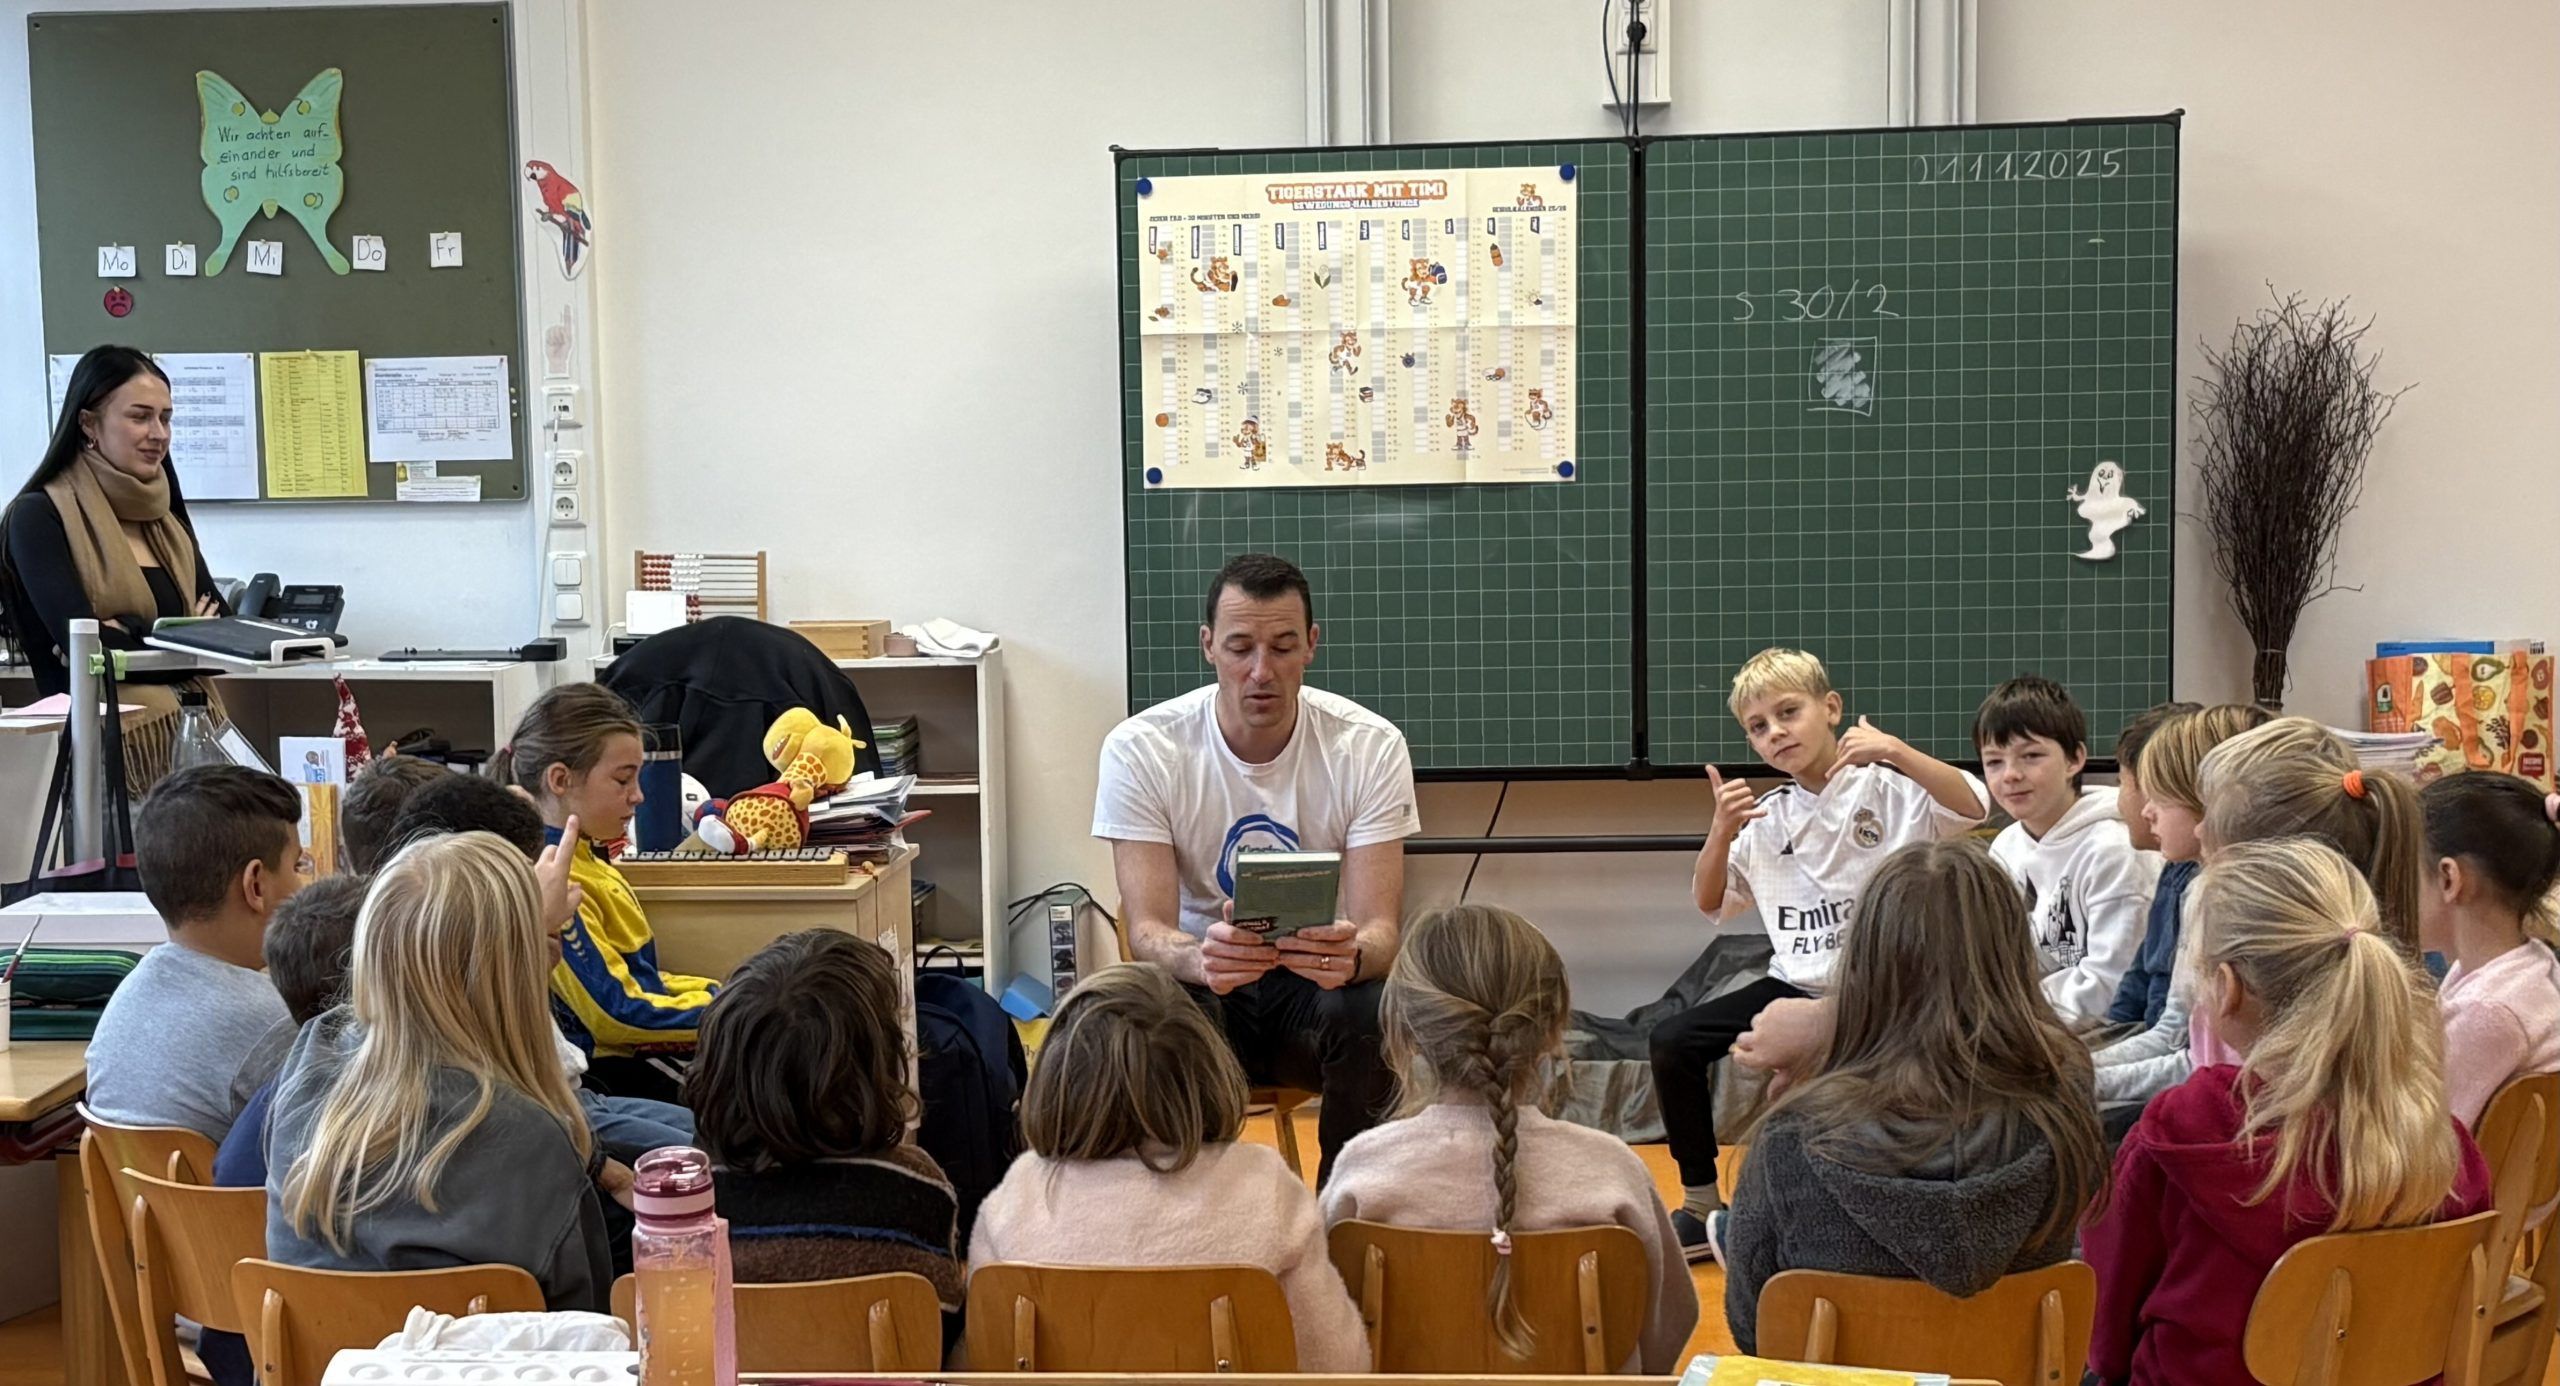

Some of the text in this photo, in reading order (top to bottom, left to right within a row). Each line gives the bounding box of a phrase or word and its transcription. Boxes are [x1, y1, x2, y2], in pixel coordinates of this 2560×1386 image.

[218, 126, 239, 142] Wir
[246, 126, 291, 141] achten
[219, 143, 316, 164] einander und
[231, 163, 330, 181] sind hilfsbereit
[1268, 181, 1446, 201] TIGERSTARK MIT TIMI
[171, 248, 189, 271] Di
[253, 245, 276, 267] Mi
[357, 238, 382, 262] Do
[435, 238, 455, 260] Fr
[102, 251, 129, 272] Mo
[1733, 291, 1755, 320] S
[1778, 898, 1855, 931] Emira
[1792, 936, 1823, 954] FLY
